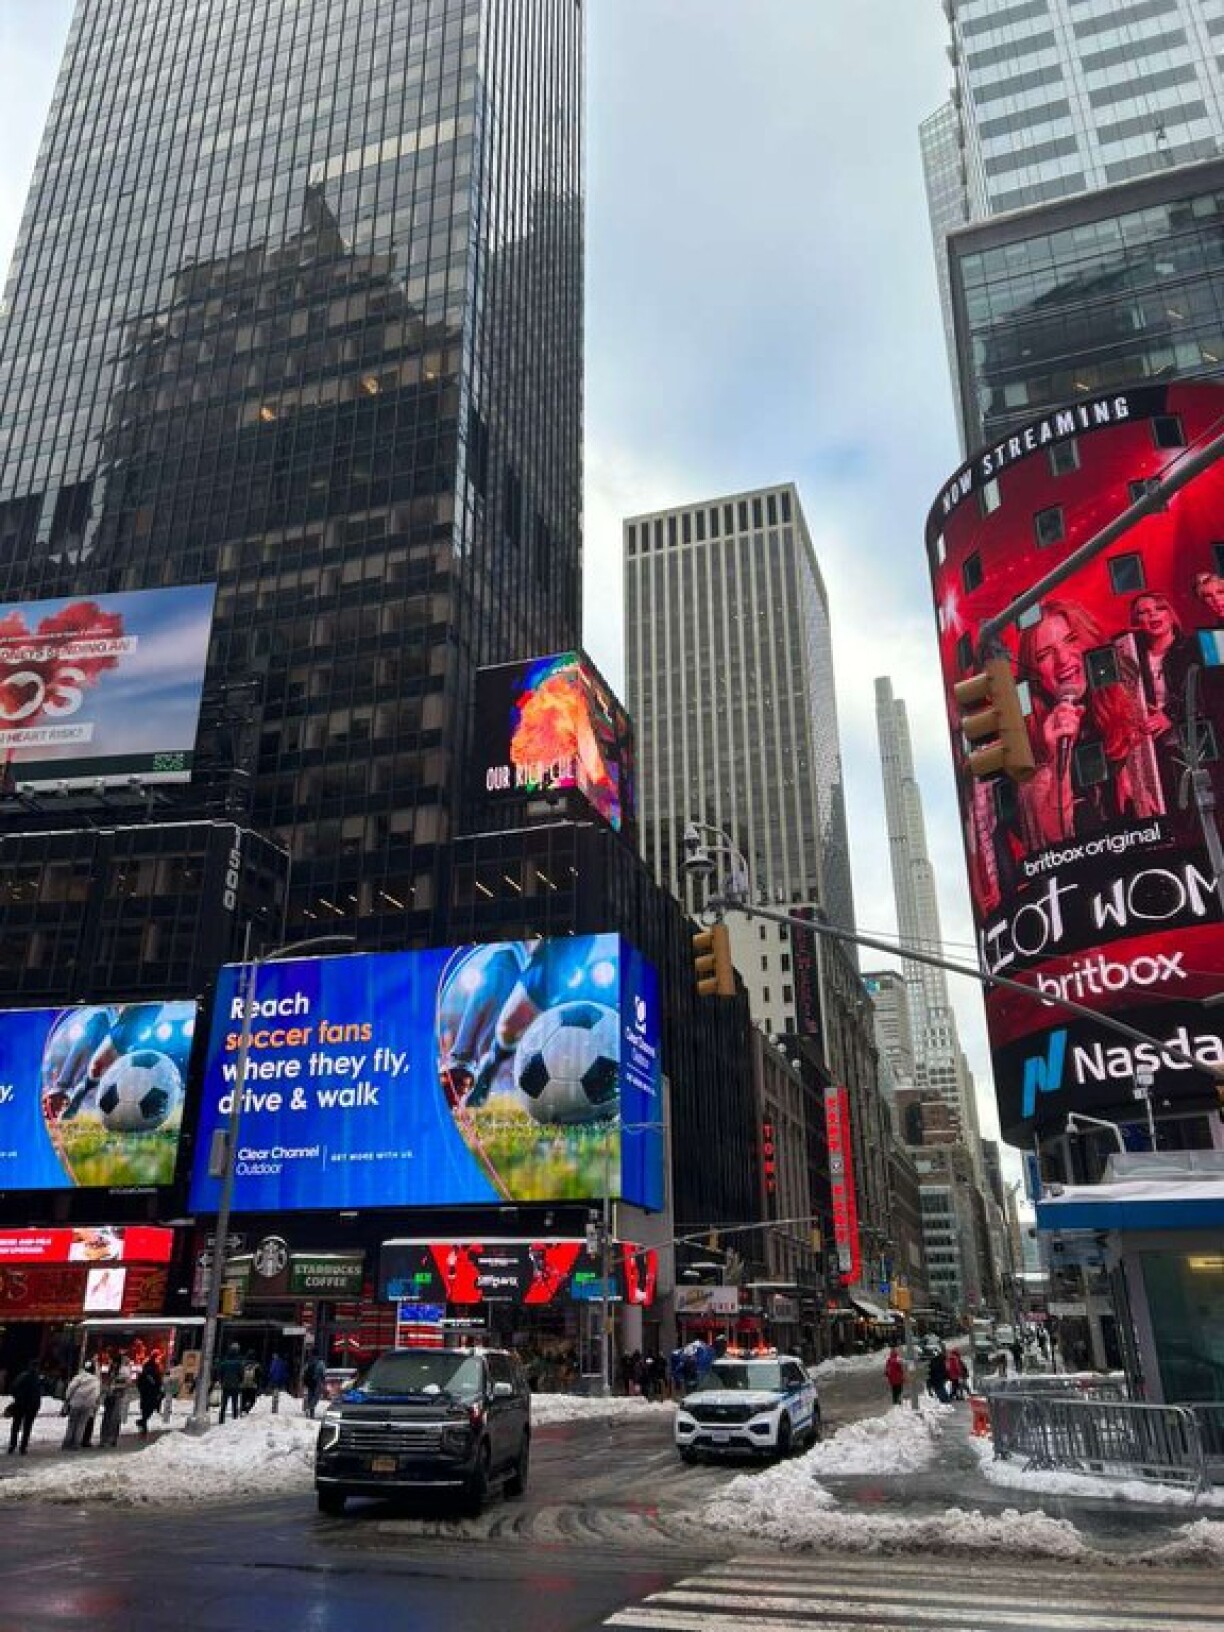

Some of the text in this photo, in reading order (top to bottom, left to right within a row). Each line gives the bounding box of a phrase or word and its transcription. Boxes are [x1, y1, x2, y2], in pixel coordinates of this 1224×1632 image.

[943, 397, 1130, 514] NOW STREAMING
[486, 765, 510, 791] OUR
[1023, 823, 1159, 876] britbox original
[1037, 951, 1187, 1005] britbox
[230, 992, 310, 1019] Reach
[225, 1019, 373, 1052] soccer fans
[222, 1048, 410, 1082] where they fly,
[218, 1083, 379, 1114] dive & walk
[236, 1162, 283, 1175] Outdoor
[237, 1145, 320, 1161] Clear Channel
[305, 1275, 348, 1287] COFFEE
